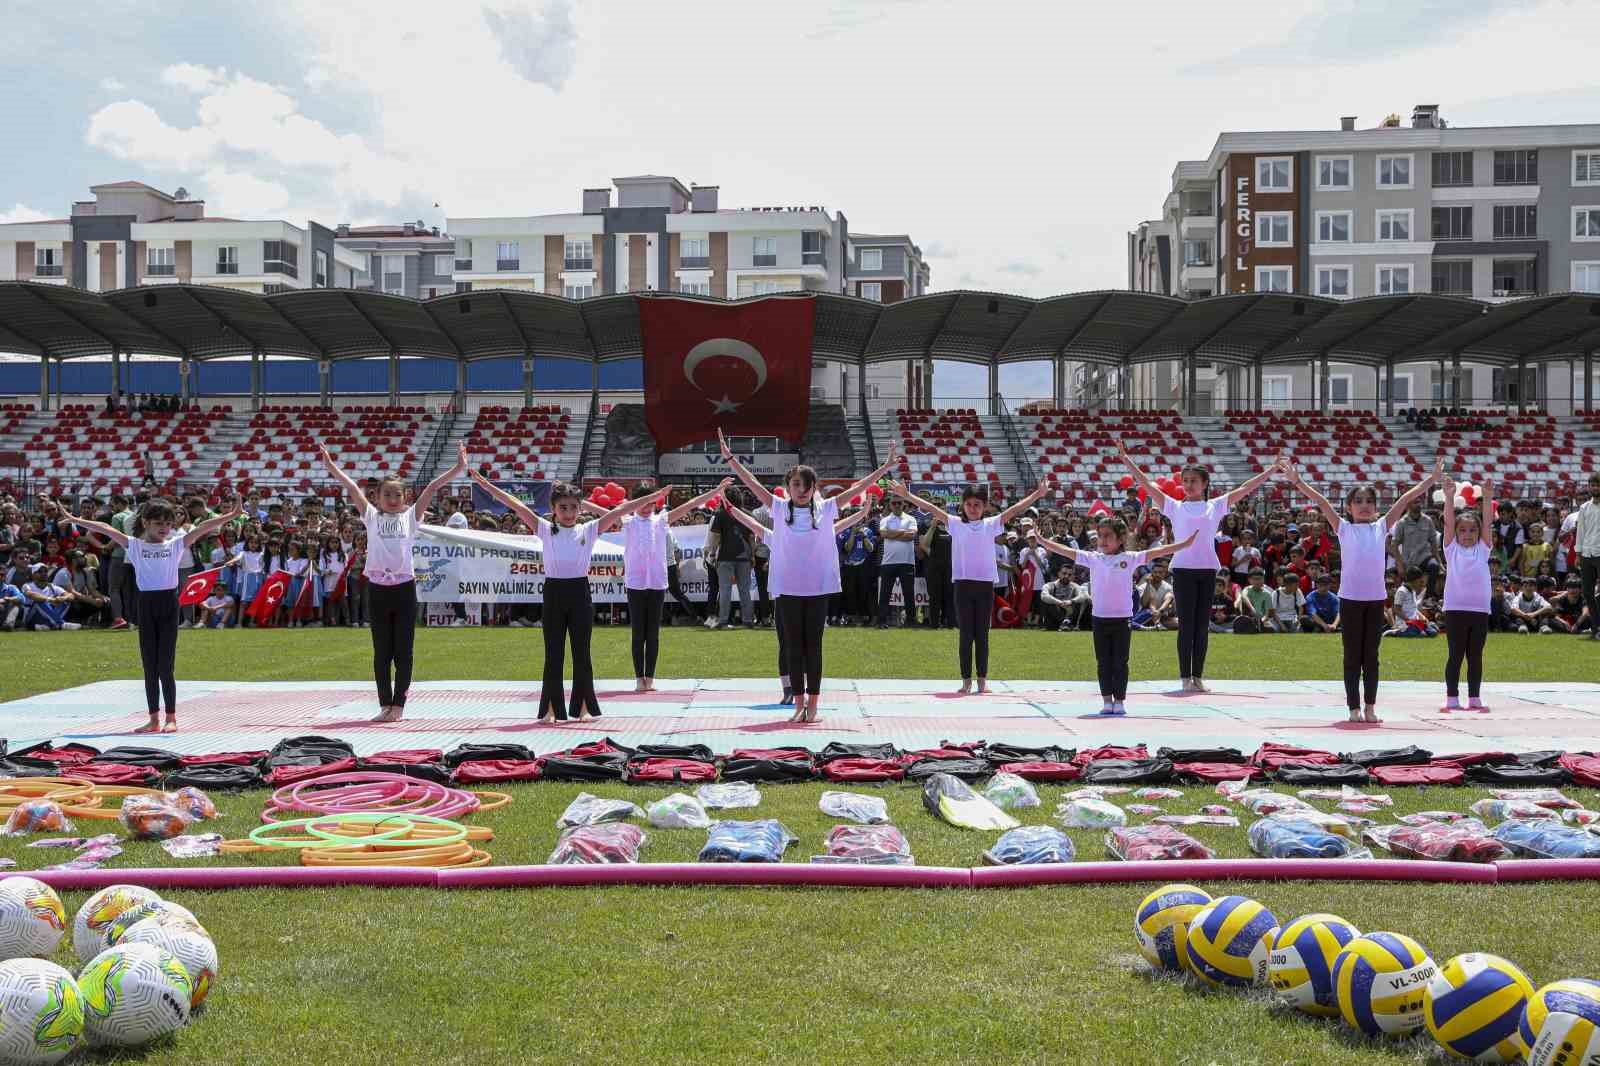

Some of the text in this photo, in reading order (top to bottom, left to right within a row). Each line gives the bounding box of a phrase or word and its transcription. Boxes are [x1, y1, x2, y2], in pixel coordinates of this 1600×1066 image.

[412, 545, 441, 558] POR
[446, 546, 476, 558] VAN
[458, 582, 490, 594] SAYIN
[493, 580, 535, 594] VALİMİZ
[429, 614, 479, 625] FUTOL
